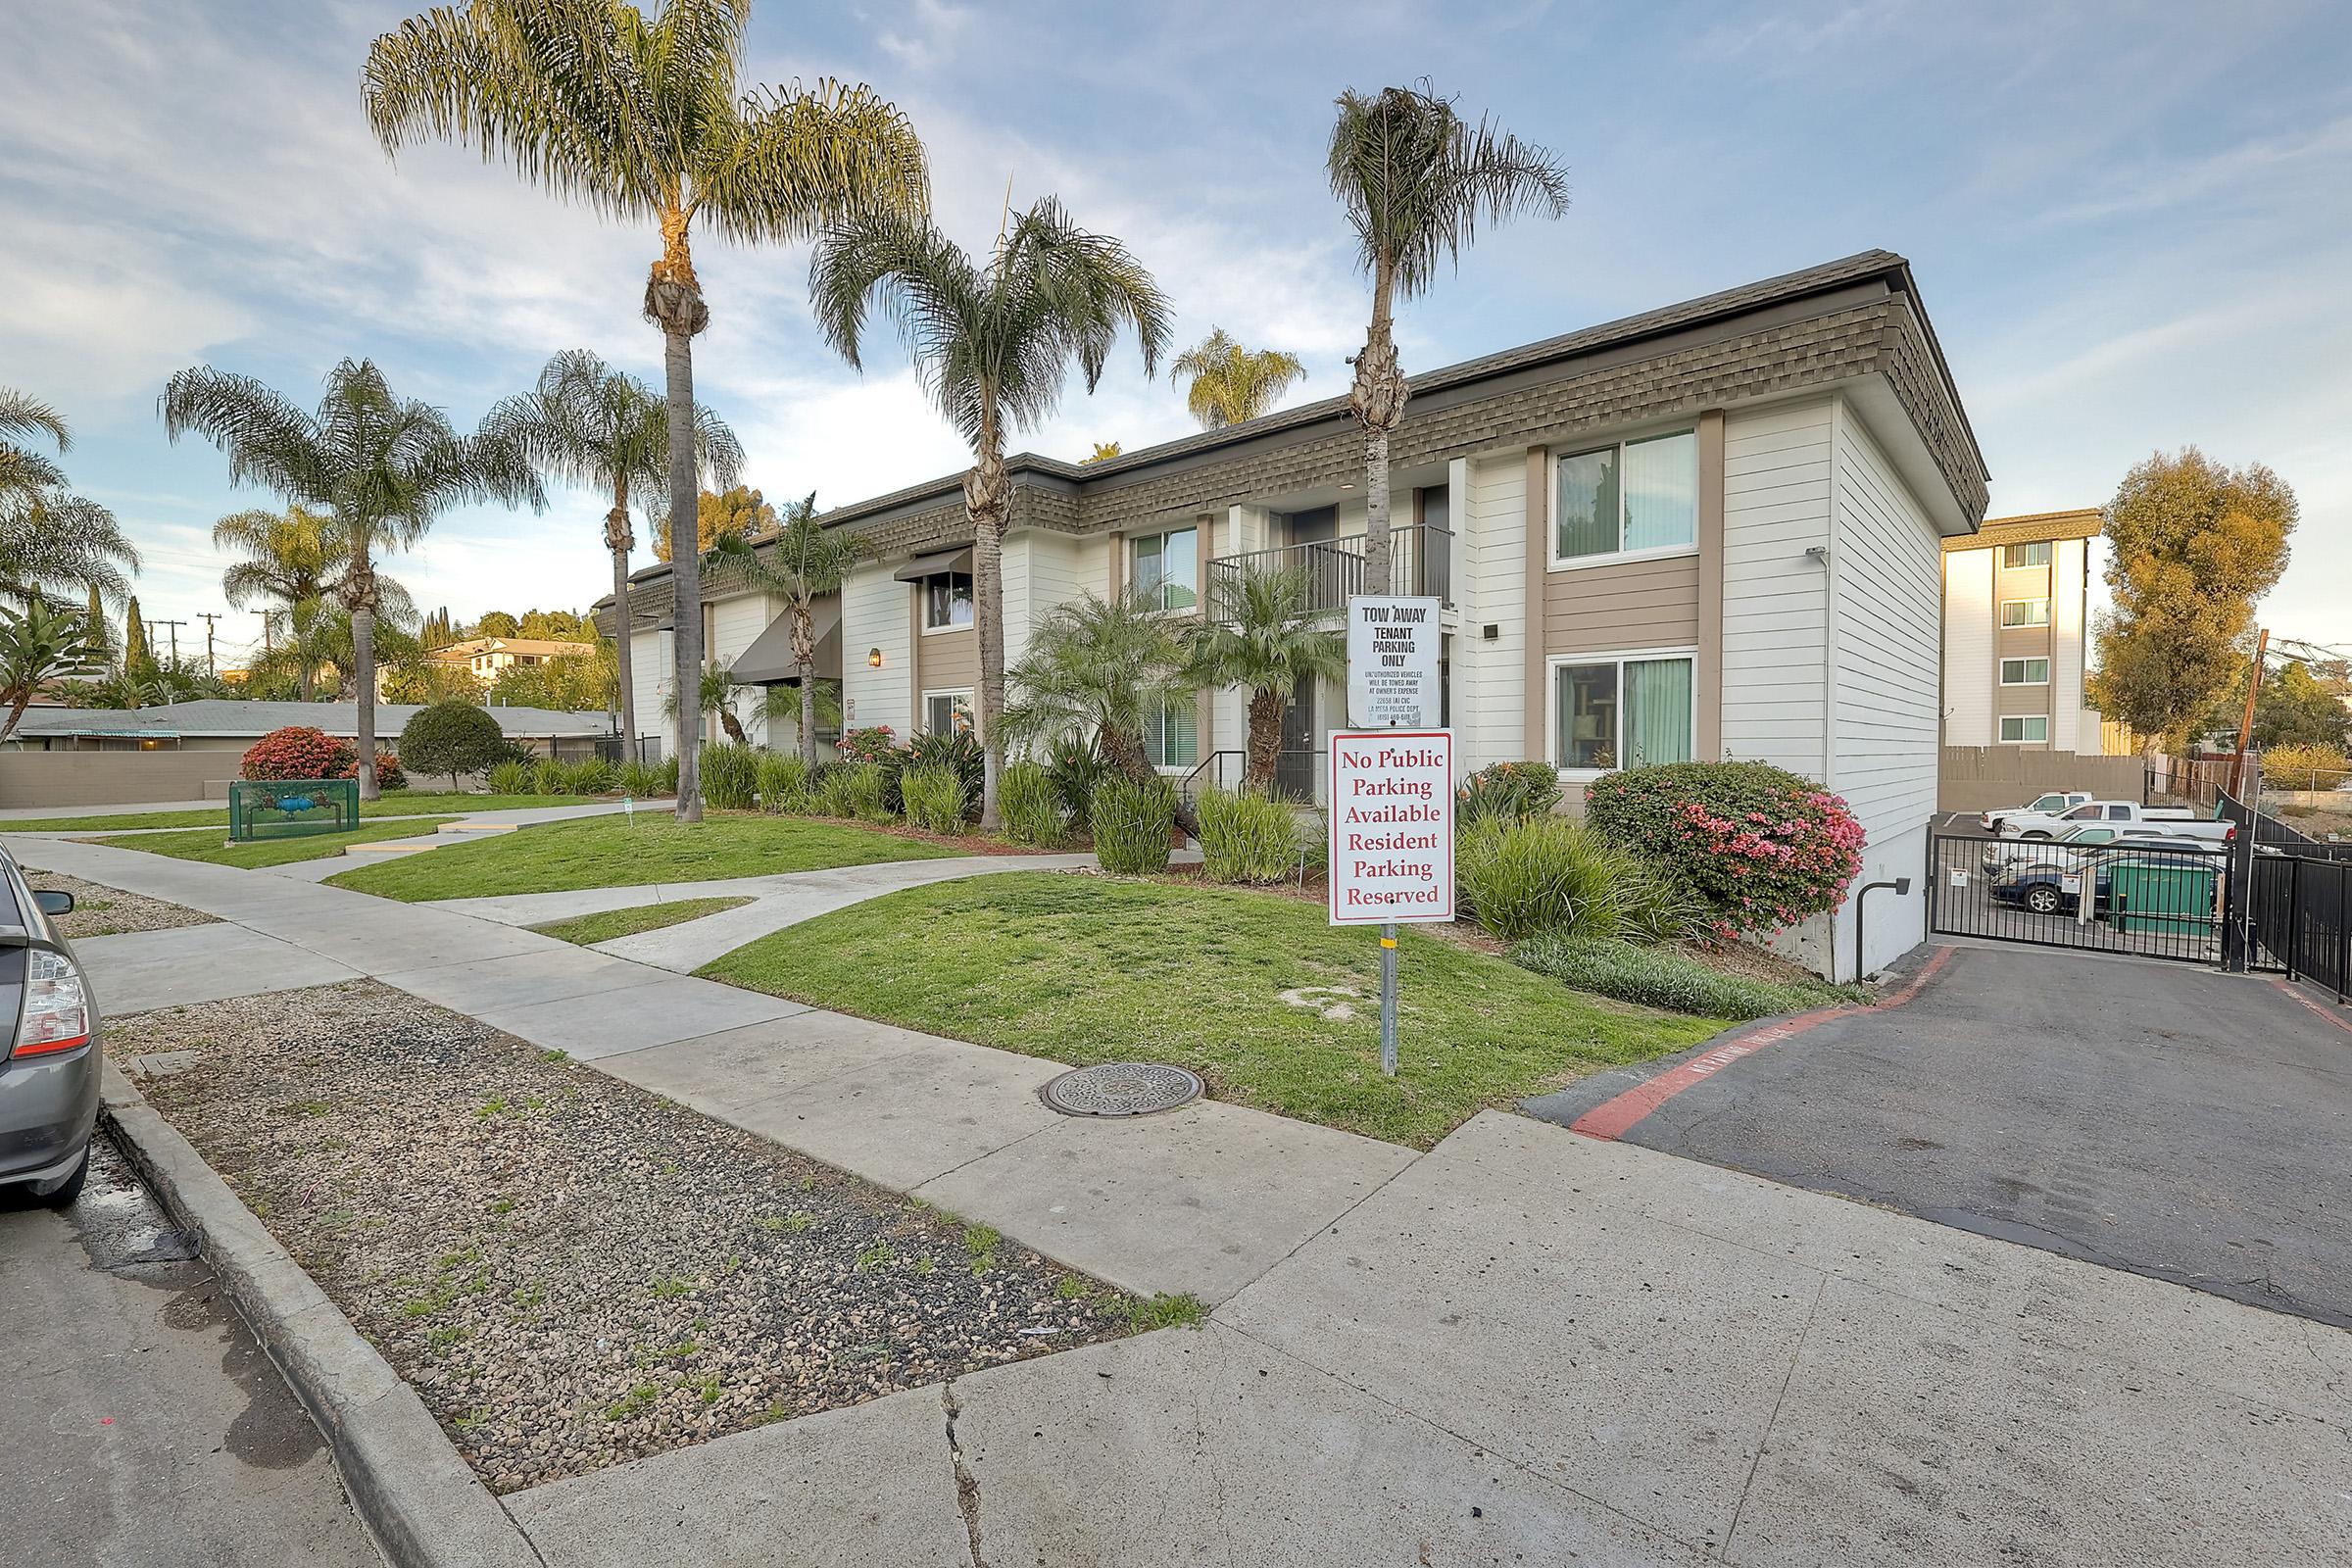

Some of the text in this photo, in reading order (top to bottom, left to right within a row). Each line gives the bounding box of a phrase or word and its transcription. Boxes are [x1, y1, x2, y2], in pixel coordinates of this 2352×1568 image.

[1362, 607, 1427, 623] TOW AWAY
[1374, 627, 1413, 640] TENANT
[1372, 641, 1415, 654] PARKING
[1382, 655, 1405, 667] ONLY
[1342, 749, 1444, 769] No Public
[1352, 777, 1433, 801] Parking
[1345, 804, 1441, 824] Available
[1348, 831, 1438, 852] Resident
[1353, 858, 1434, 882] Parking
[1348, 885, 1440, 906] Reserved
